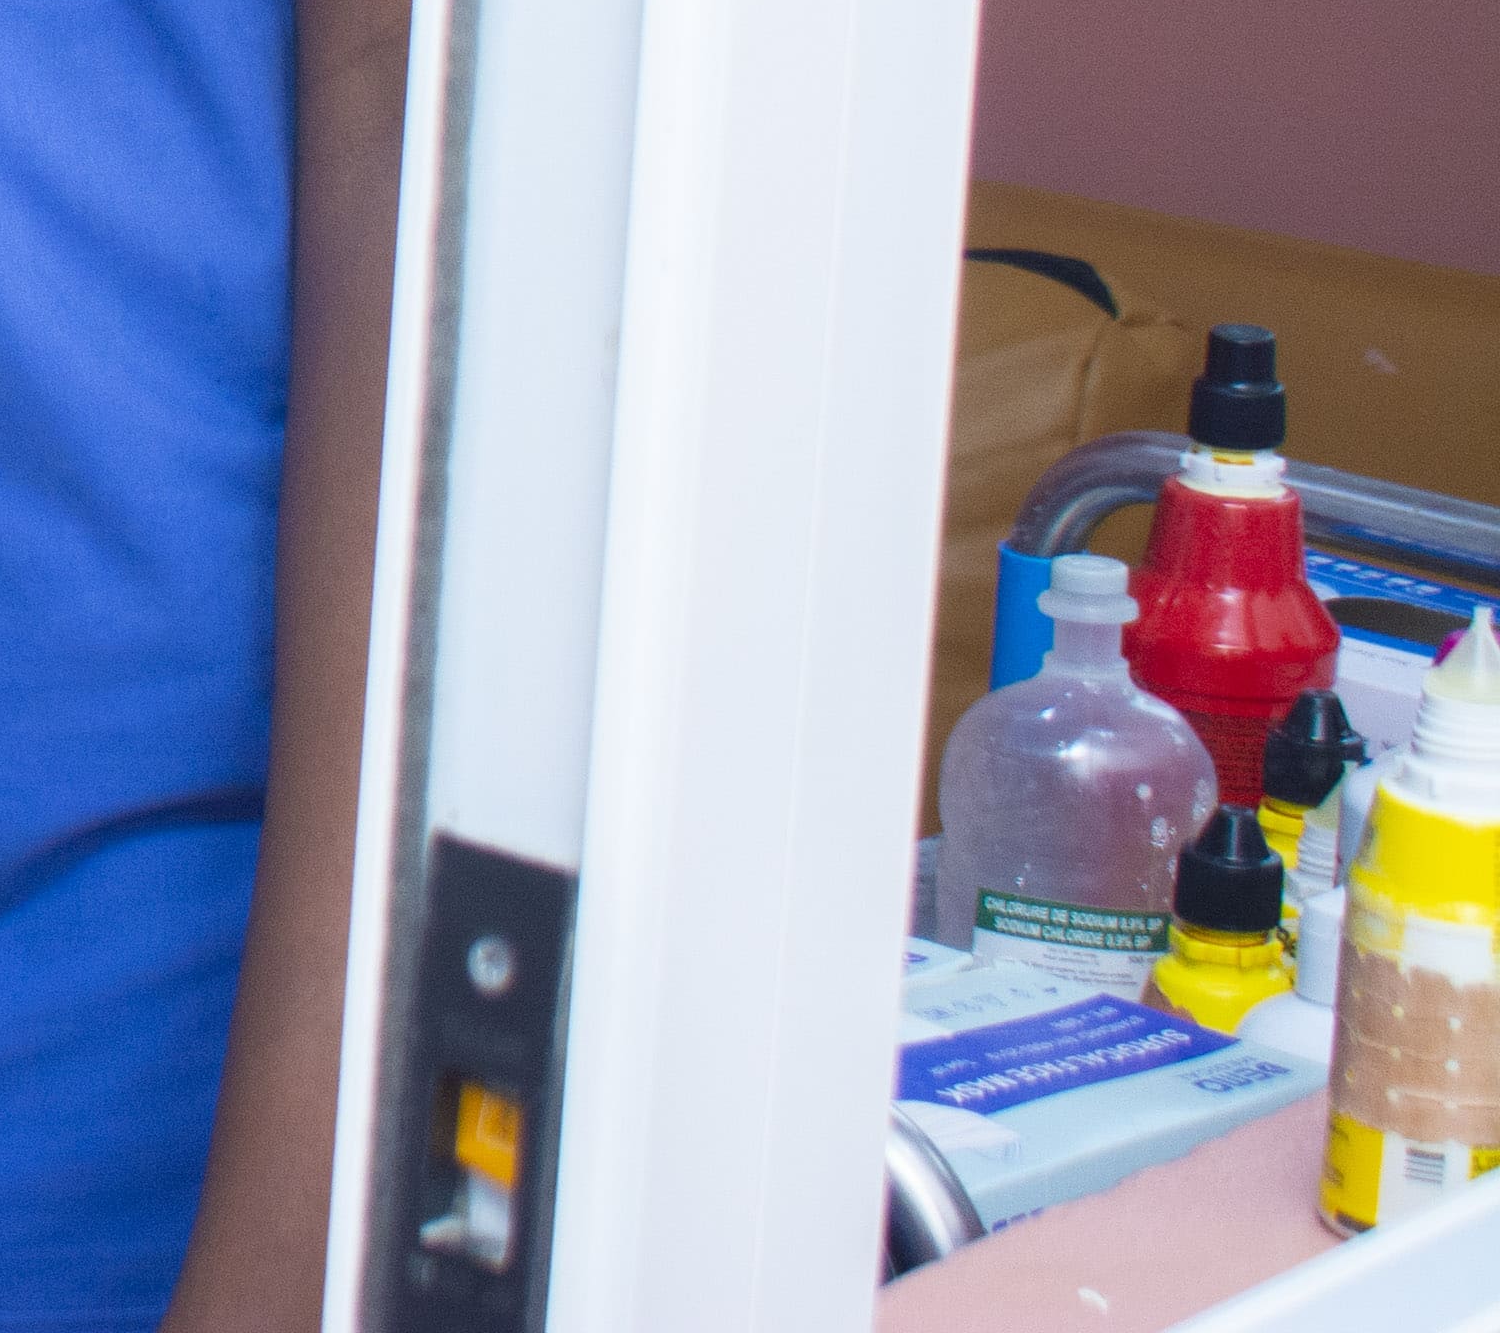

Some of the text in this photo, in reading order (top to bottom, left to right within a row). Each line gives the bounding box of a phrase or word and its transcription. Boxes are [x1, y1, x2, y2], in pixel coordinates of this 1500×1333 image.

[994, 915, 1041, 939] SODIUM
[1050, 907, 1069, 925] DE
[1069, 910, 1118, 931] SODIUM
[1073, 1029, 1191, 1068] SURGICAL
[1012, 1055, 1075, 1085] FACE
[937, 1073, 1010, 1105] MASK
